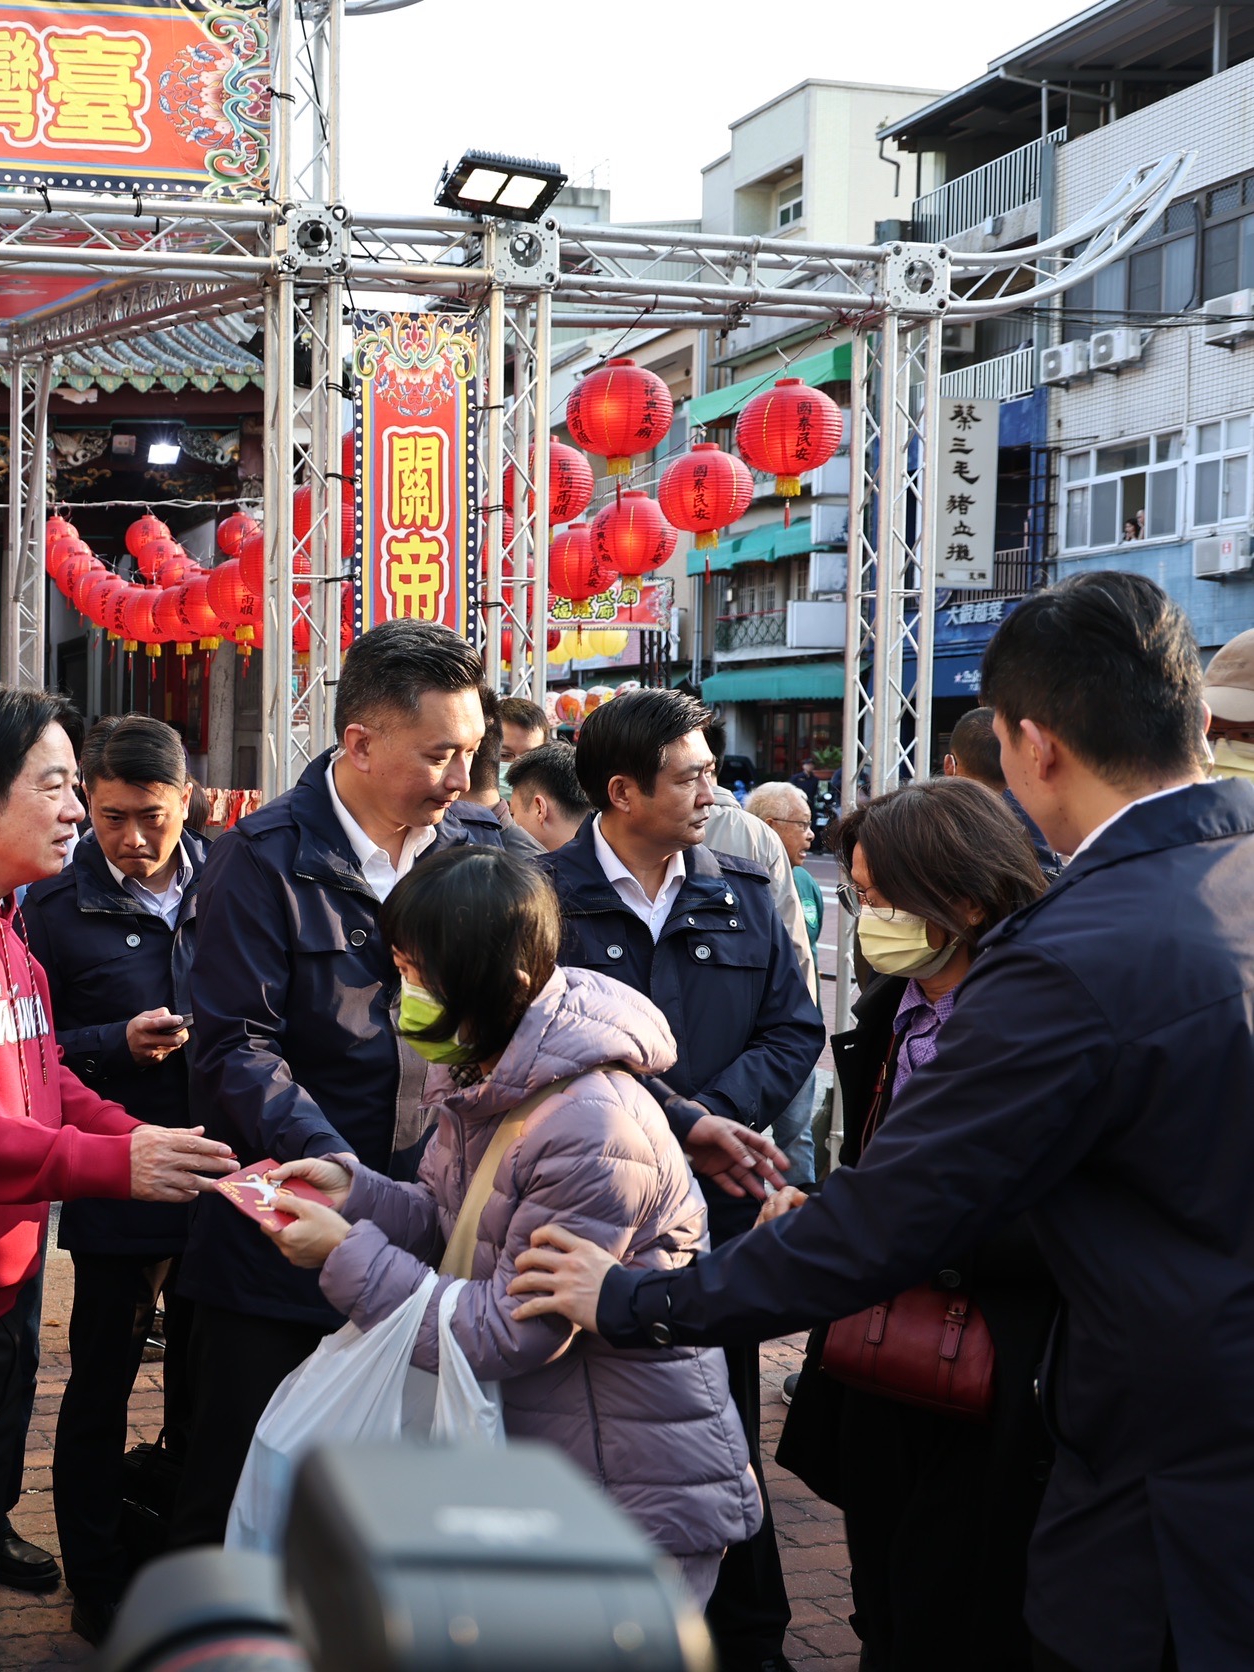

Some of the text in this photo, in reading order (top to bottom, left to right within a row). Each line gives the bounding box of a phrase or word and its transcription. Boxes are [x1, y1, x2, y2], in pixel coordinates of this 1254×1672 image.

[790, 401, 814, 461] 國泰民安
[552, 459, 573, 516] 風調雨順
[692, 464, 711, 521] 國泰民安
[390, 435, 440, 620] 關帝
